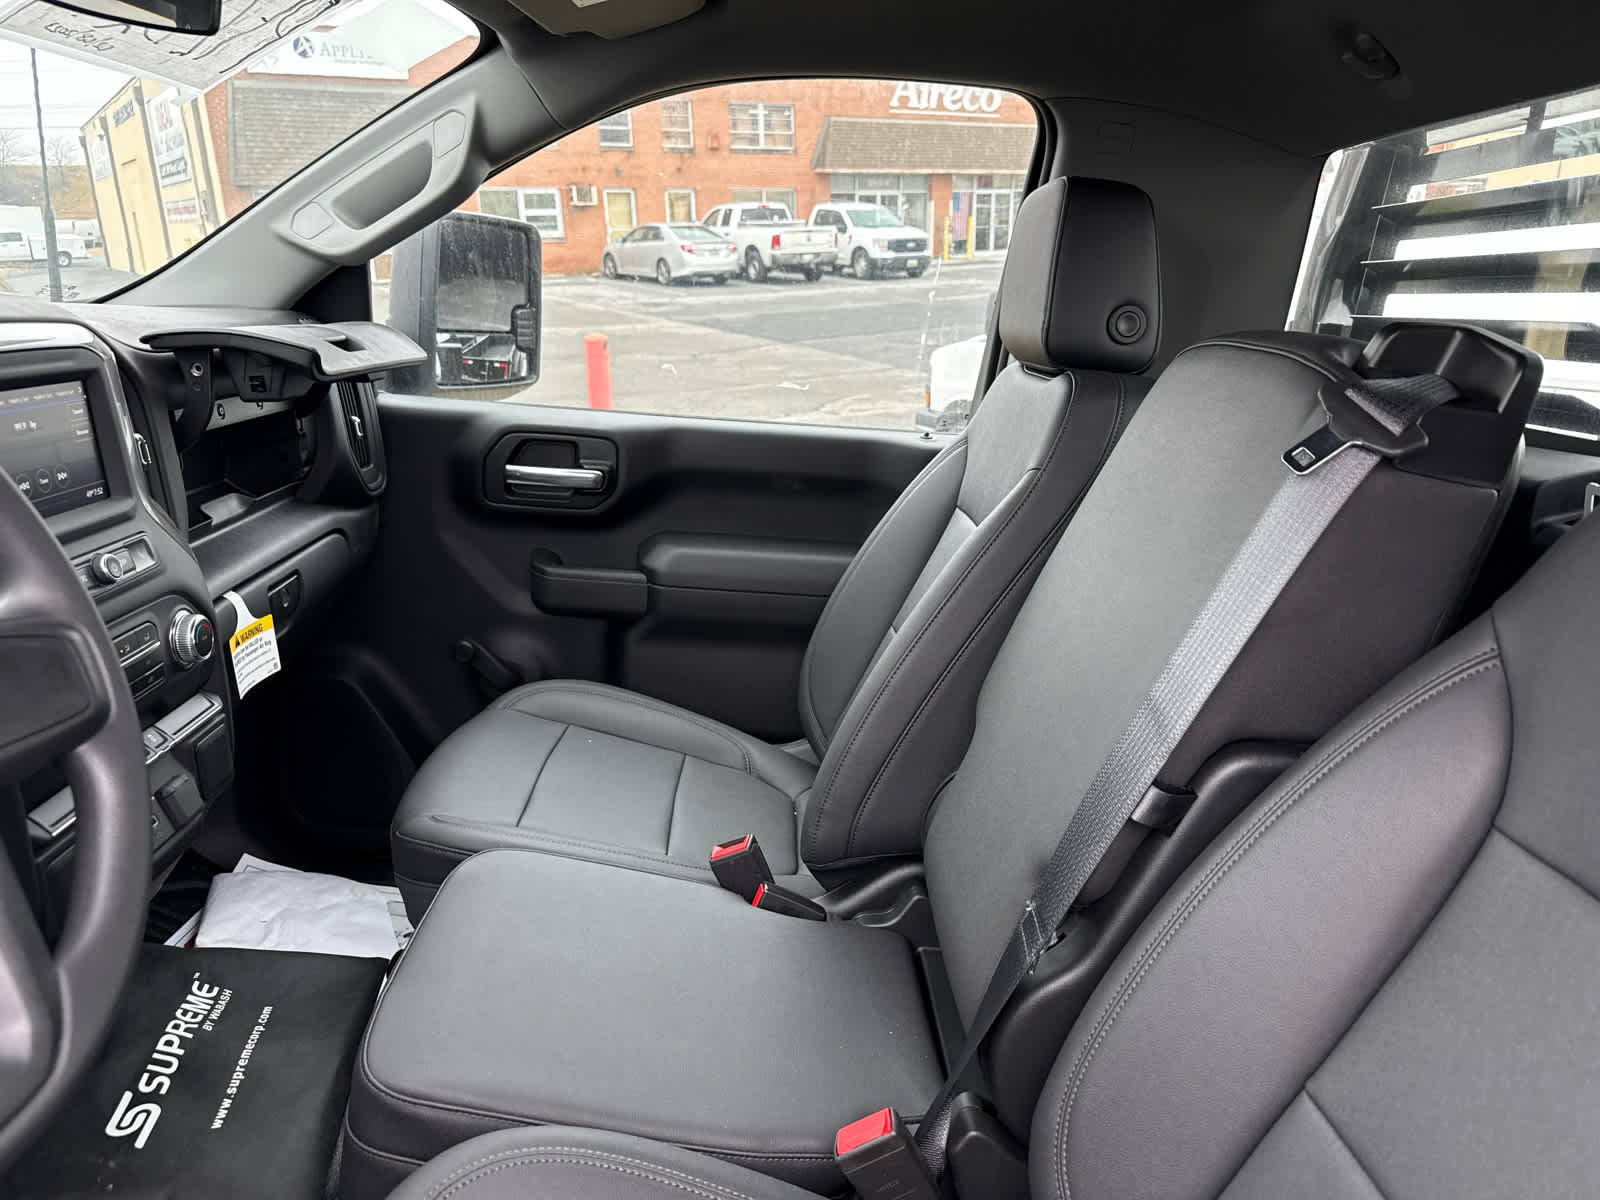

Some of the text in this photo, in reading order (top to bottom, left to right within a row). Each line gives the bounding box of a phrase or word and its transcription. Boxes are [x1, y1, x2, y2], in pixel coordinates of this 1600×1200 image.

[138, 980, 220, 1095] SUPREME
[202, 988, 233, 1032] BY WABASH
[211, 1006, 273, 1129] www.supremecorp.com
